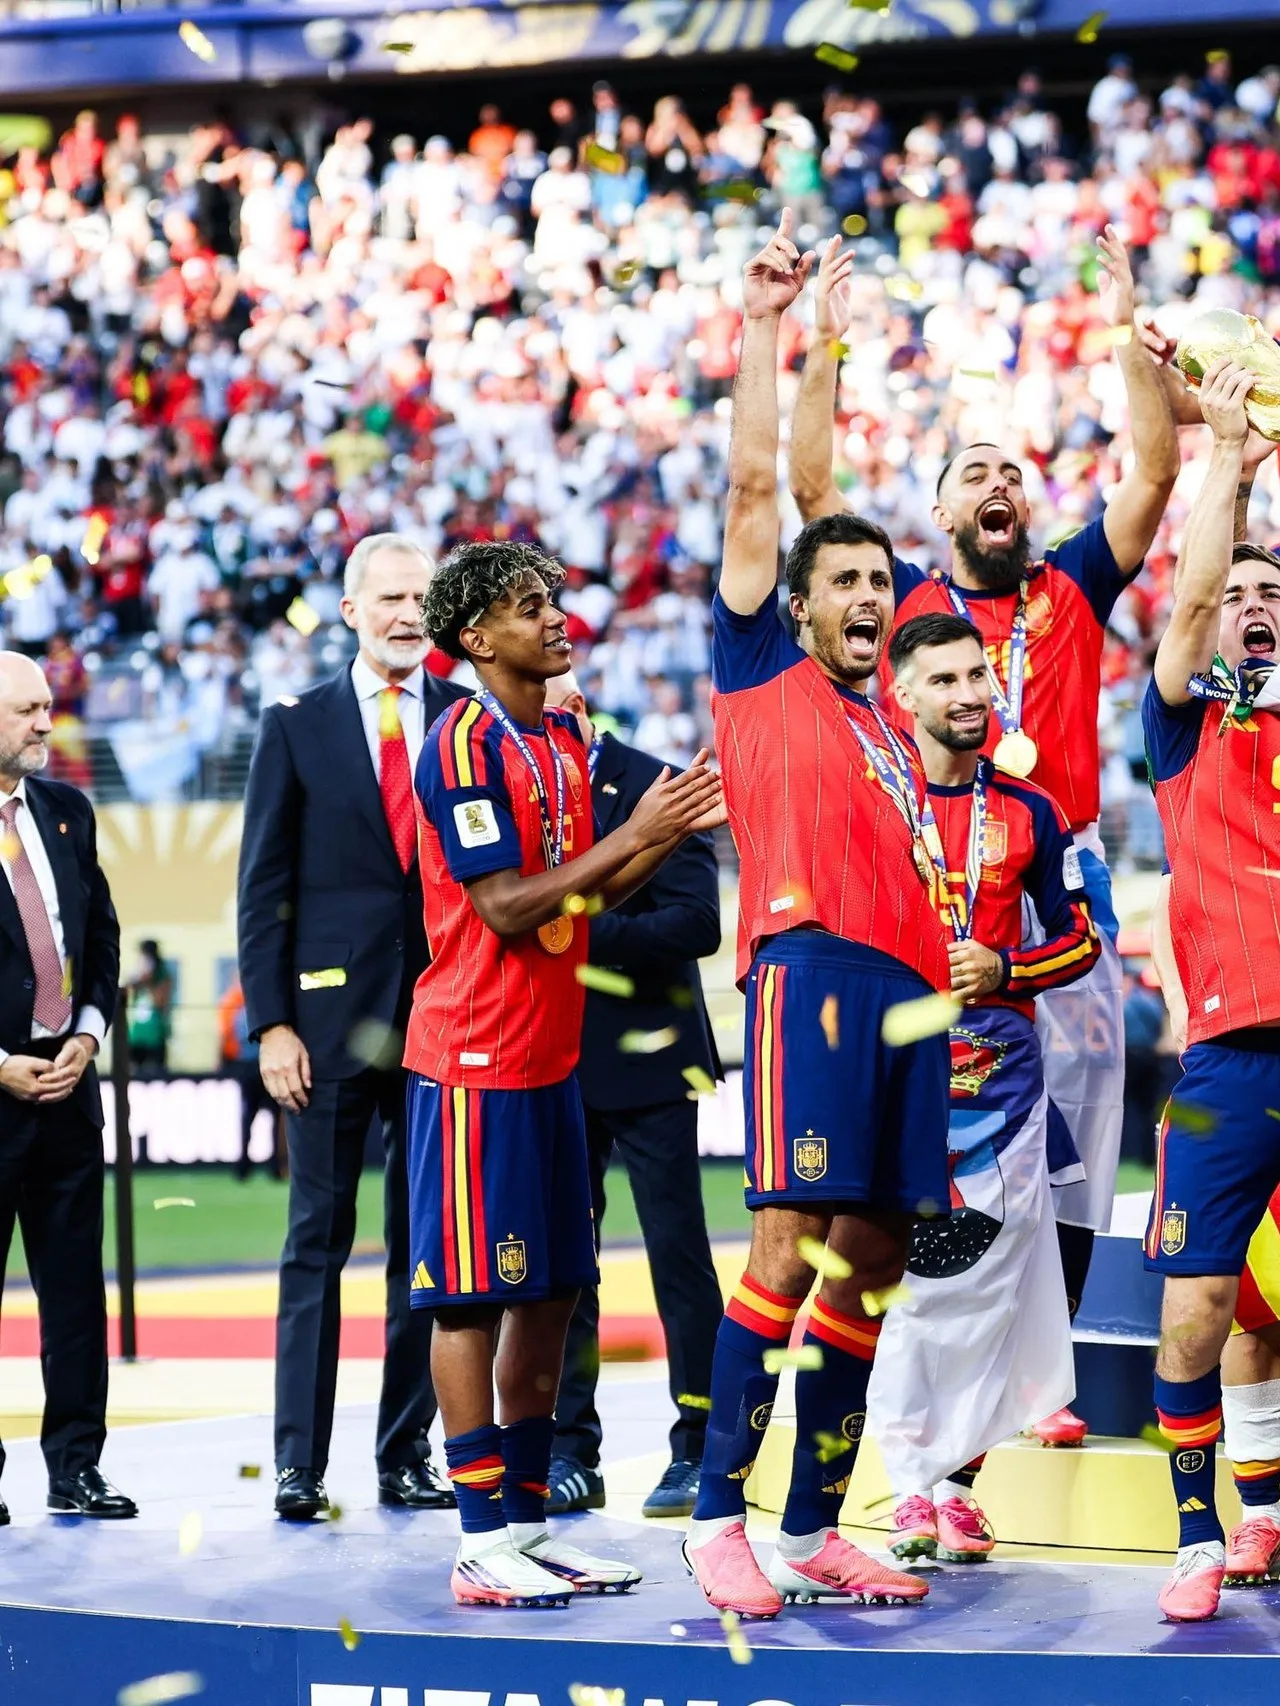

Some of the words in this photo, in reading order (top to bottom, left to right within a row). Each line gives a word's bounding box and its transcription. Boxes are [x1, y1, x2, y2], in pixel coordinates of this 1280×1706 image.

[1188, 679, 1204, 694] FIFA
[1205, 687, 1232, 700] WORL
[488, 701, 506, 719] FIFA
[501, 717, 525, 748] WORLD
[522, 745, 535, 764] CUP
[875, 757, 889, 775] FIFA
